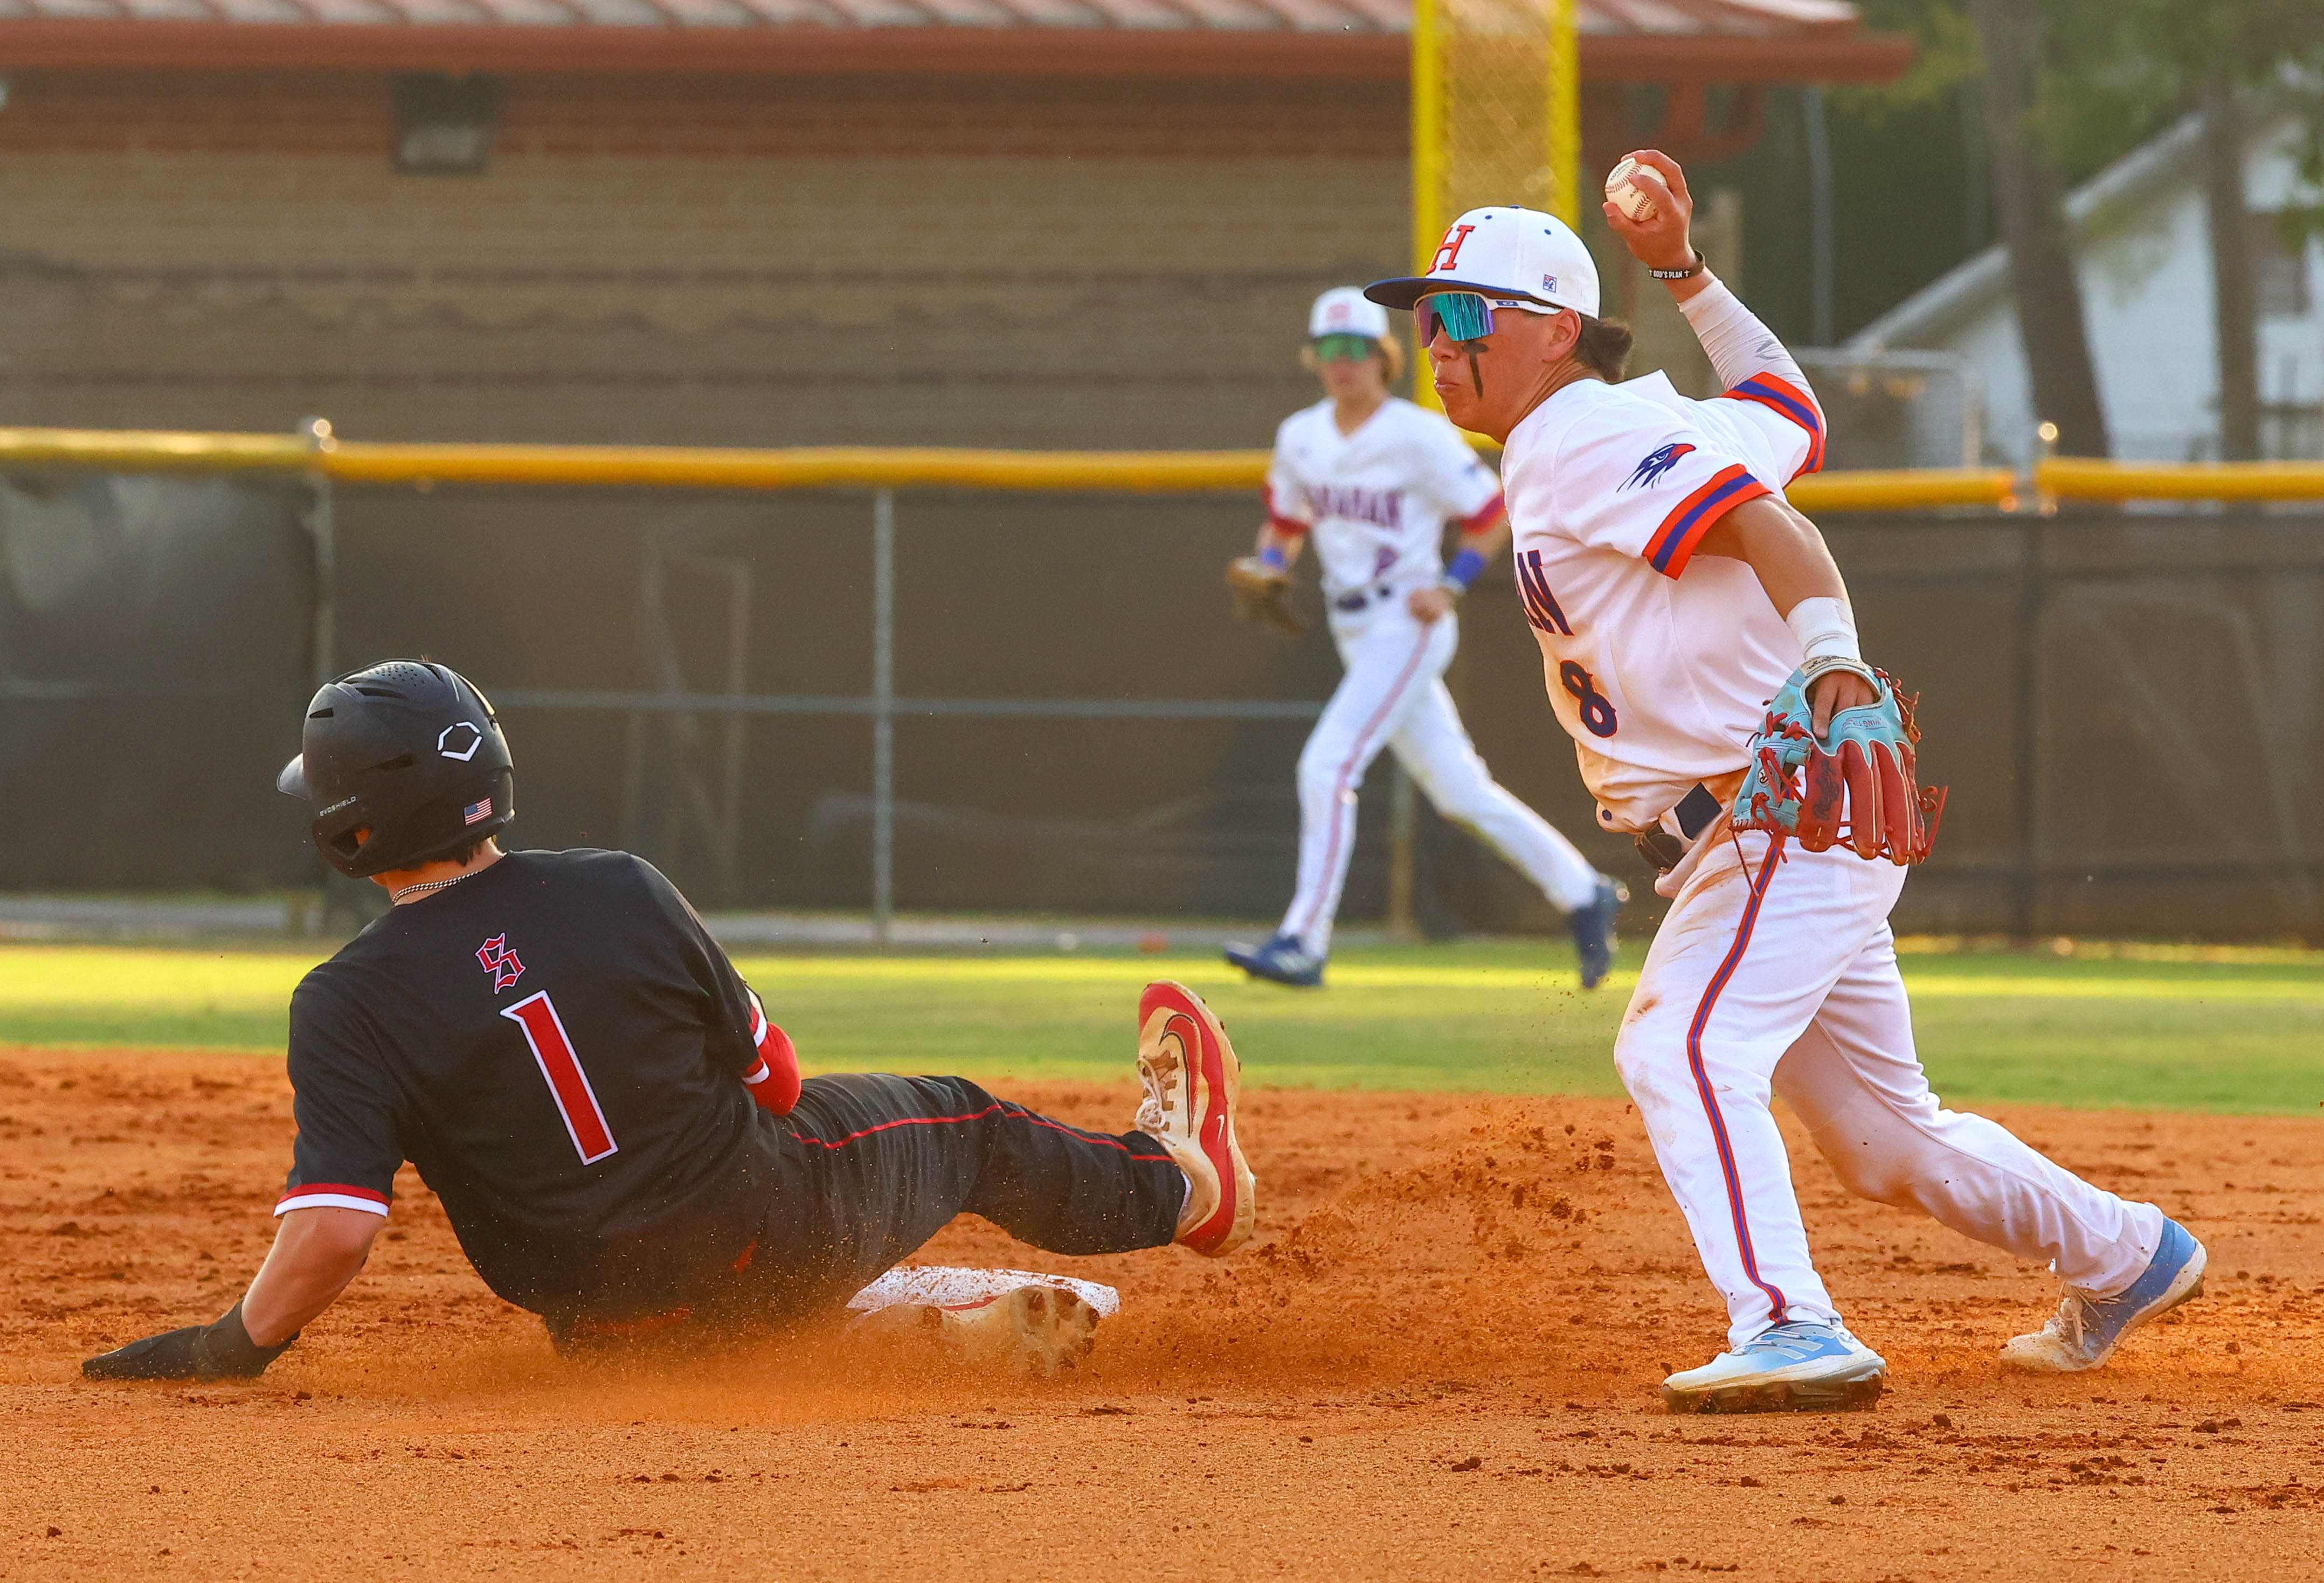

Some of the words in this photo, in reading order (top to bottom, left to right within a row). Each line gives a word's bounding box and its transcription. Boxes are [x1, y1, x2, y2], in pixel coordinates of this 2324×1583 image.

[1426, 225, 1476, 275] H
[1669, 270, 1683, 279] PLAN
[1559, 659, 1617, 738] 8
[475, 932, 526, 995] S
[500, 989, 619, 1166] 1
